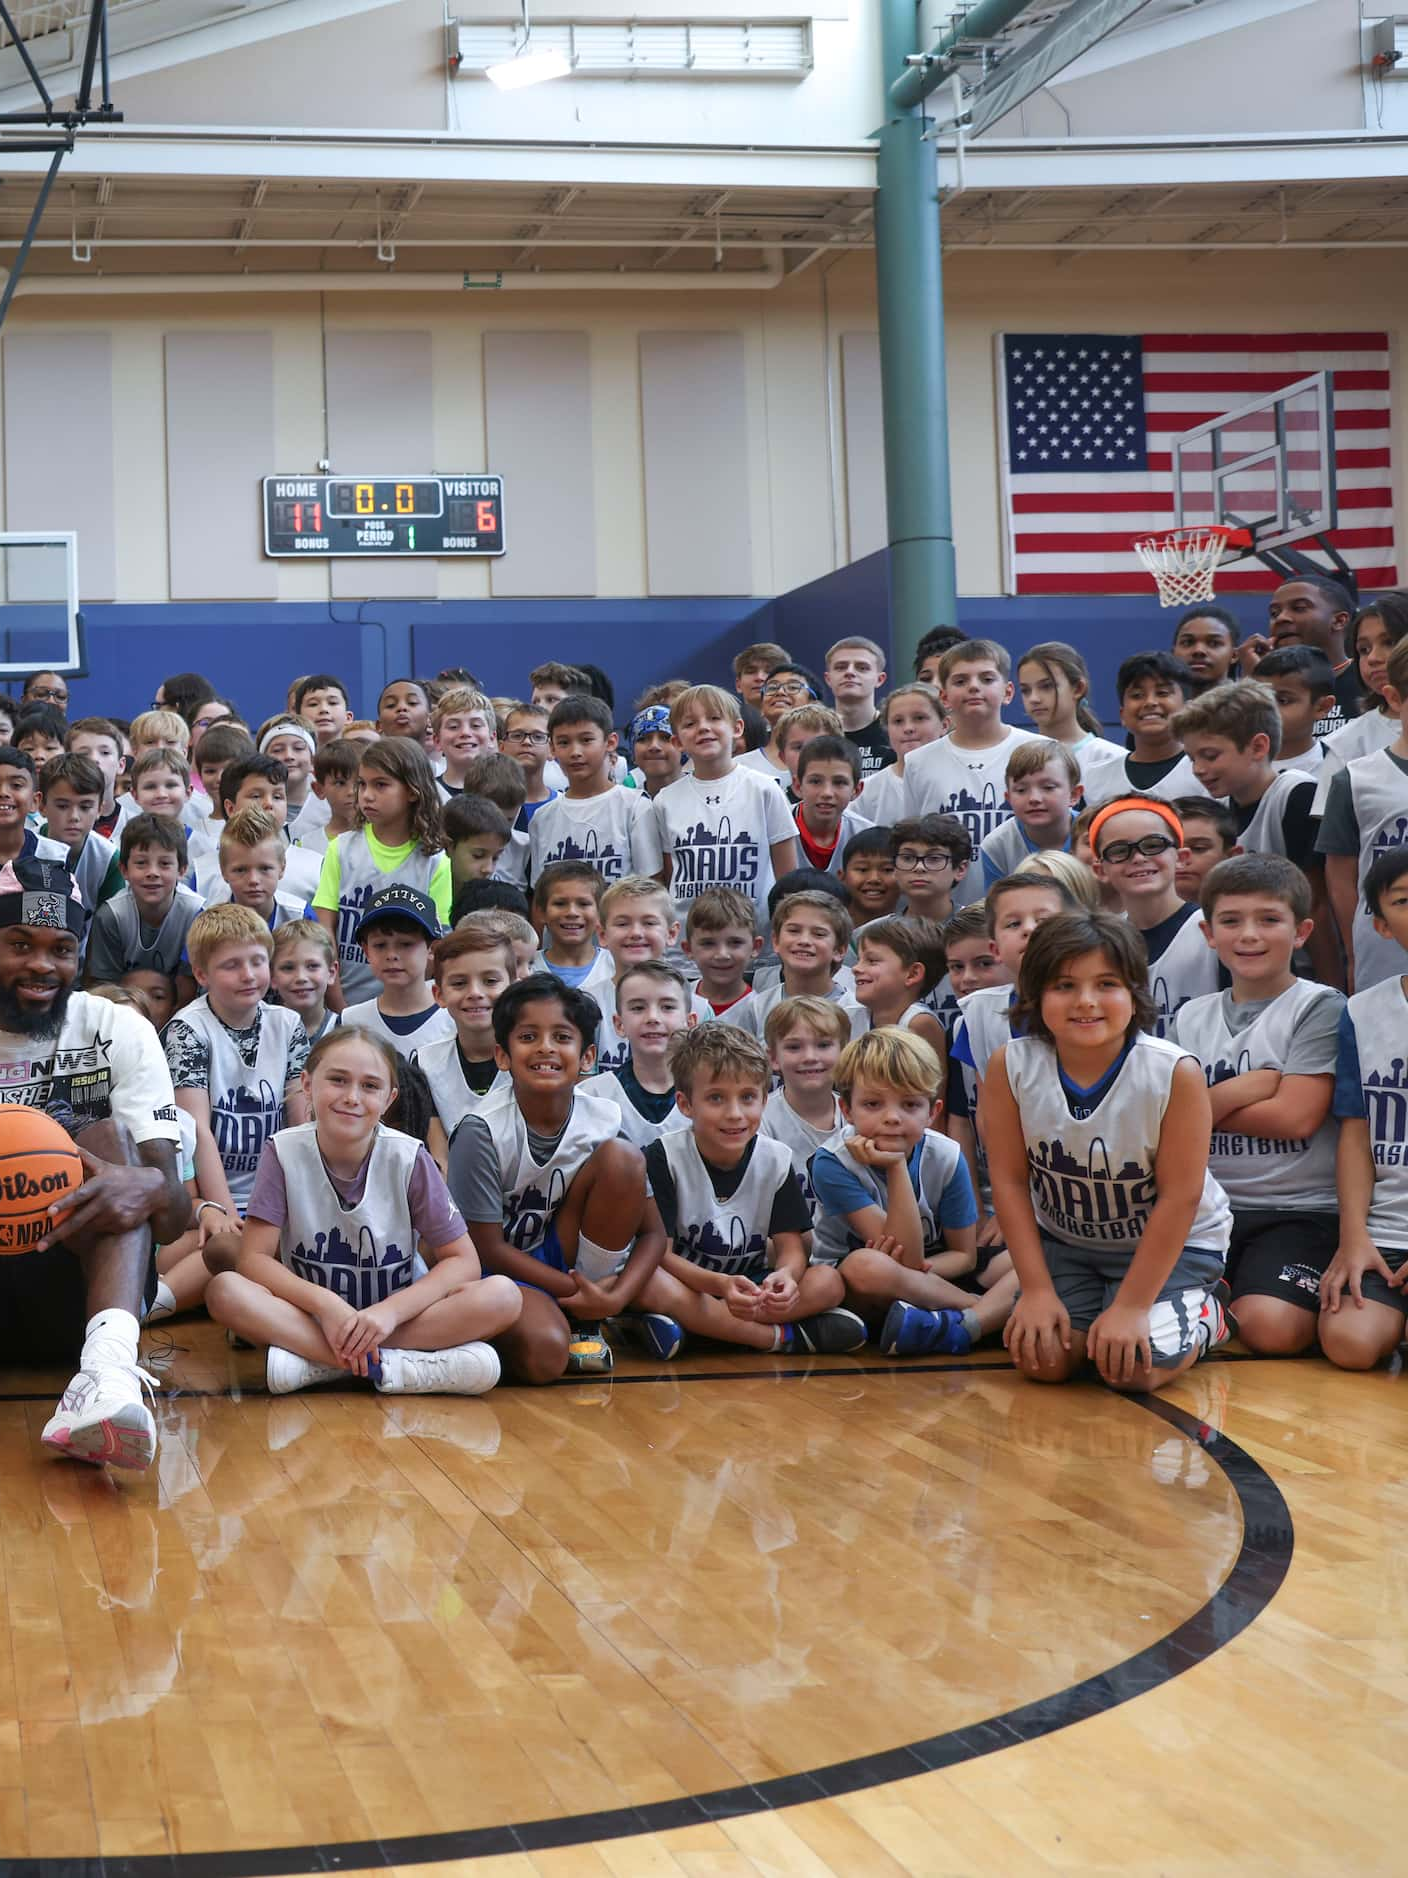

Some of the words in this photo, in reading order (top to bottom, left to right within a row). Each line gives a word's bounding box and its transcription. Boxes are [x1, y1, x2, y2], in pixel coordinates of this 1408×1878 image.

[276, 483, 318, 497] HOME
[445, 482, 499, 496] VISITOR
[294, 503, 321, 533] 11
[477, 501, 496, 532] 6
[295, 538, 329, 549] BONUS
[356, 530, 394, 542] PERIOD
[408, 525, 415, 549] 1
[443, 537, 477, 548] BONUS
[675, 846, 758, 882] MAVS
[374, 890, 426, 912] DALLAS
[16, 1216, 54, 1247] NBA
